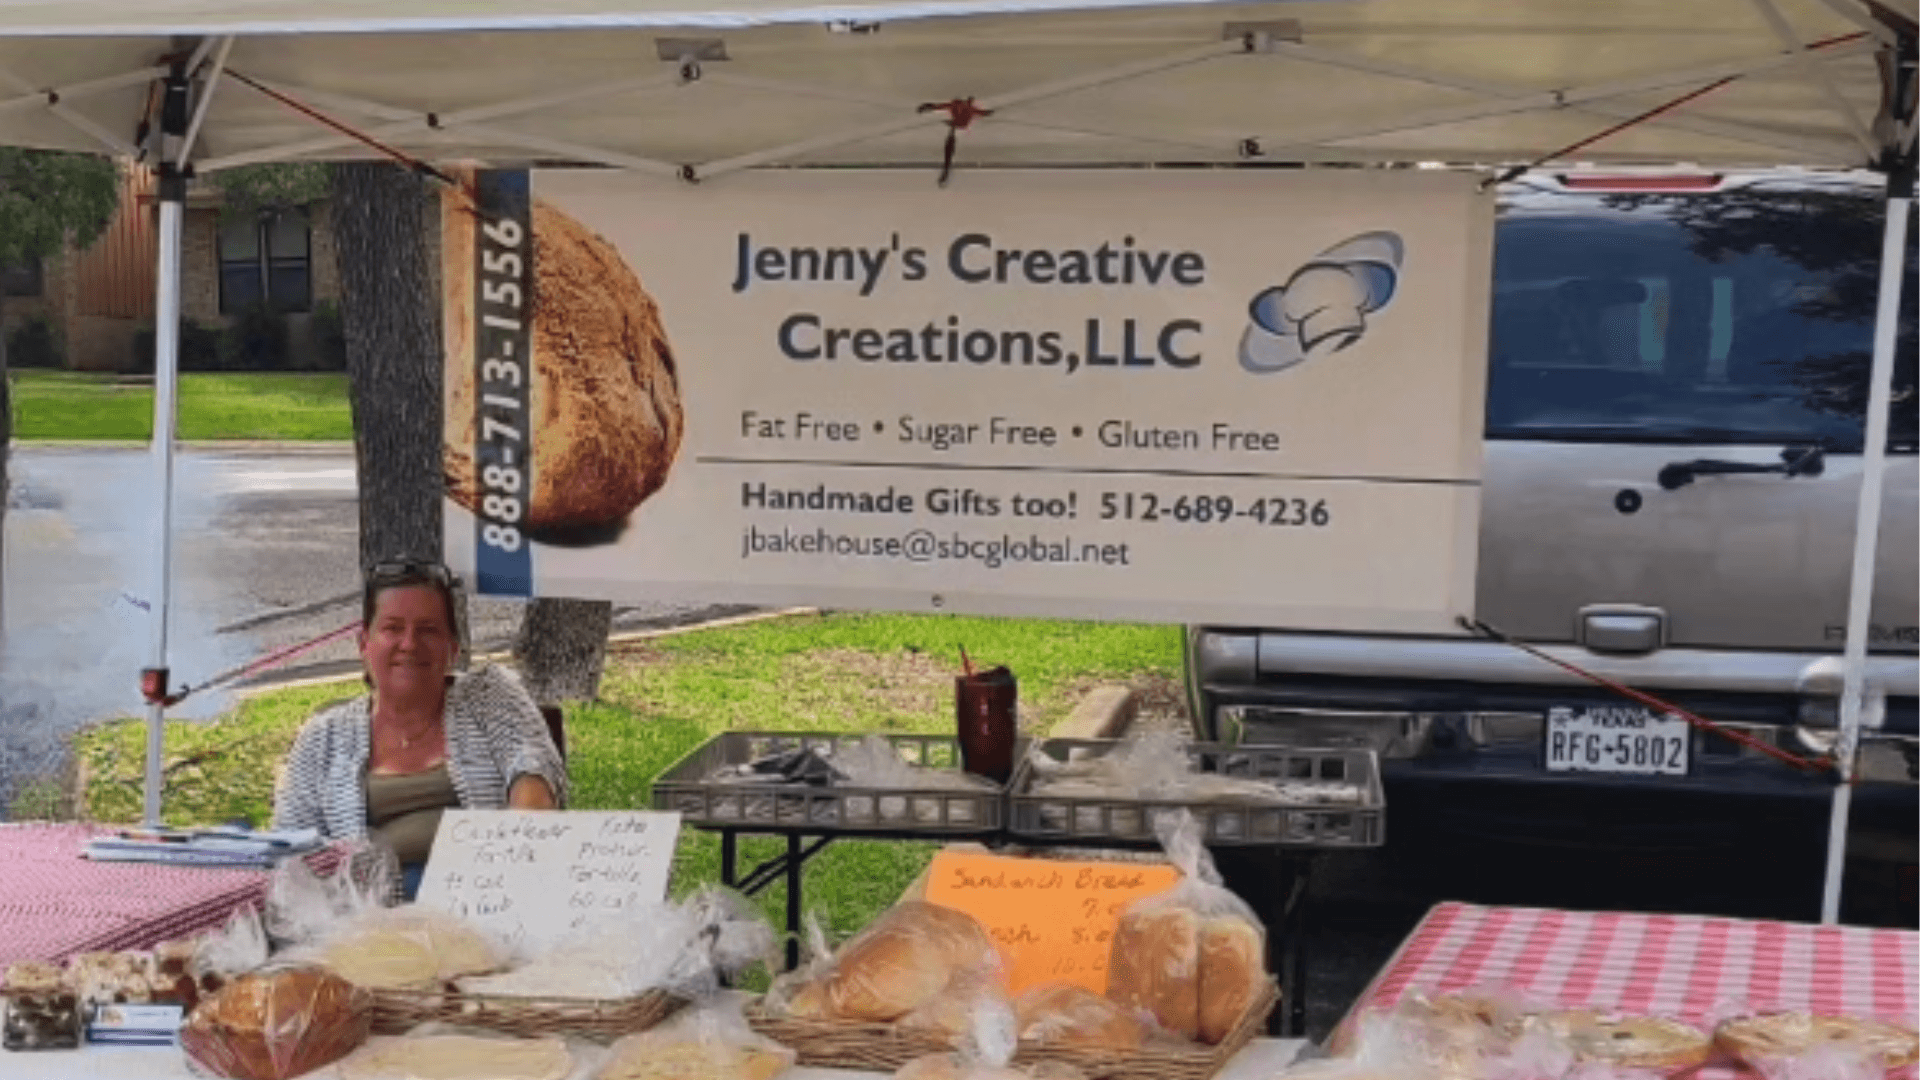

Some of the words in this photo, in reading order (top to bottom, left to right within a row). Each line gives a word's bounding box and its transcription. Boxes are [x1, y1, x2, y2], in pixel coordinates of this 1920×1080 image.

[731, 231, 927, 298] Jenny's
[946, 232, 1207, 288] Creative
[777, 312, 1204, 375] Creations,LLC
[482, 219, 524, 553] 888-713-1556
[741, 410, 787, 440] Fat
[794, 412, 861, 443] Free
[897, 414, 981, 451] Sugar
[989, 417, 1058, 447] Free
[1097, 419, 1201, 451] Gluten
[1211, 422, 1280, 452] Free
[740, 481, 915, 515] Handmade
[924, 486, 1002, 518] Gifts
[1010, 490, 1078, 520] too!
[1099, 491, 1332, 528] 512-689-4236
[741, 528, 1130, 570] jbakehouse@sbcglobal.net
[949, 866, 1064, 890] Sandwich
[1074, 866, 1146, 890] Bread
